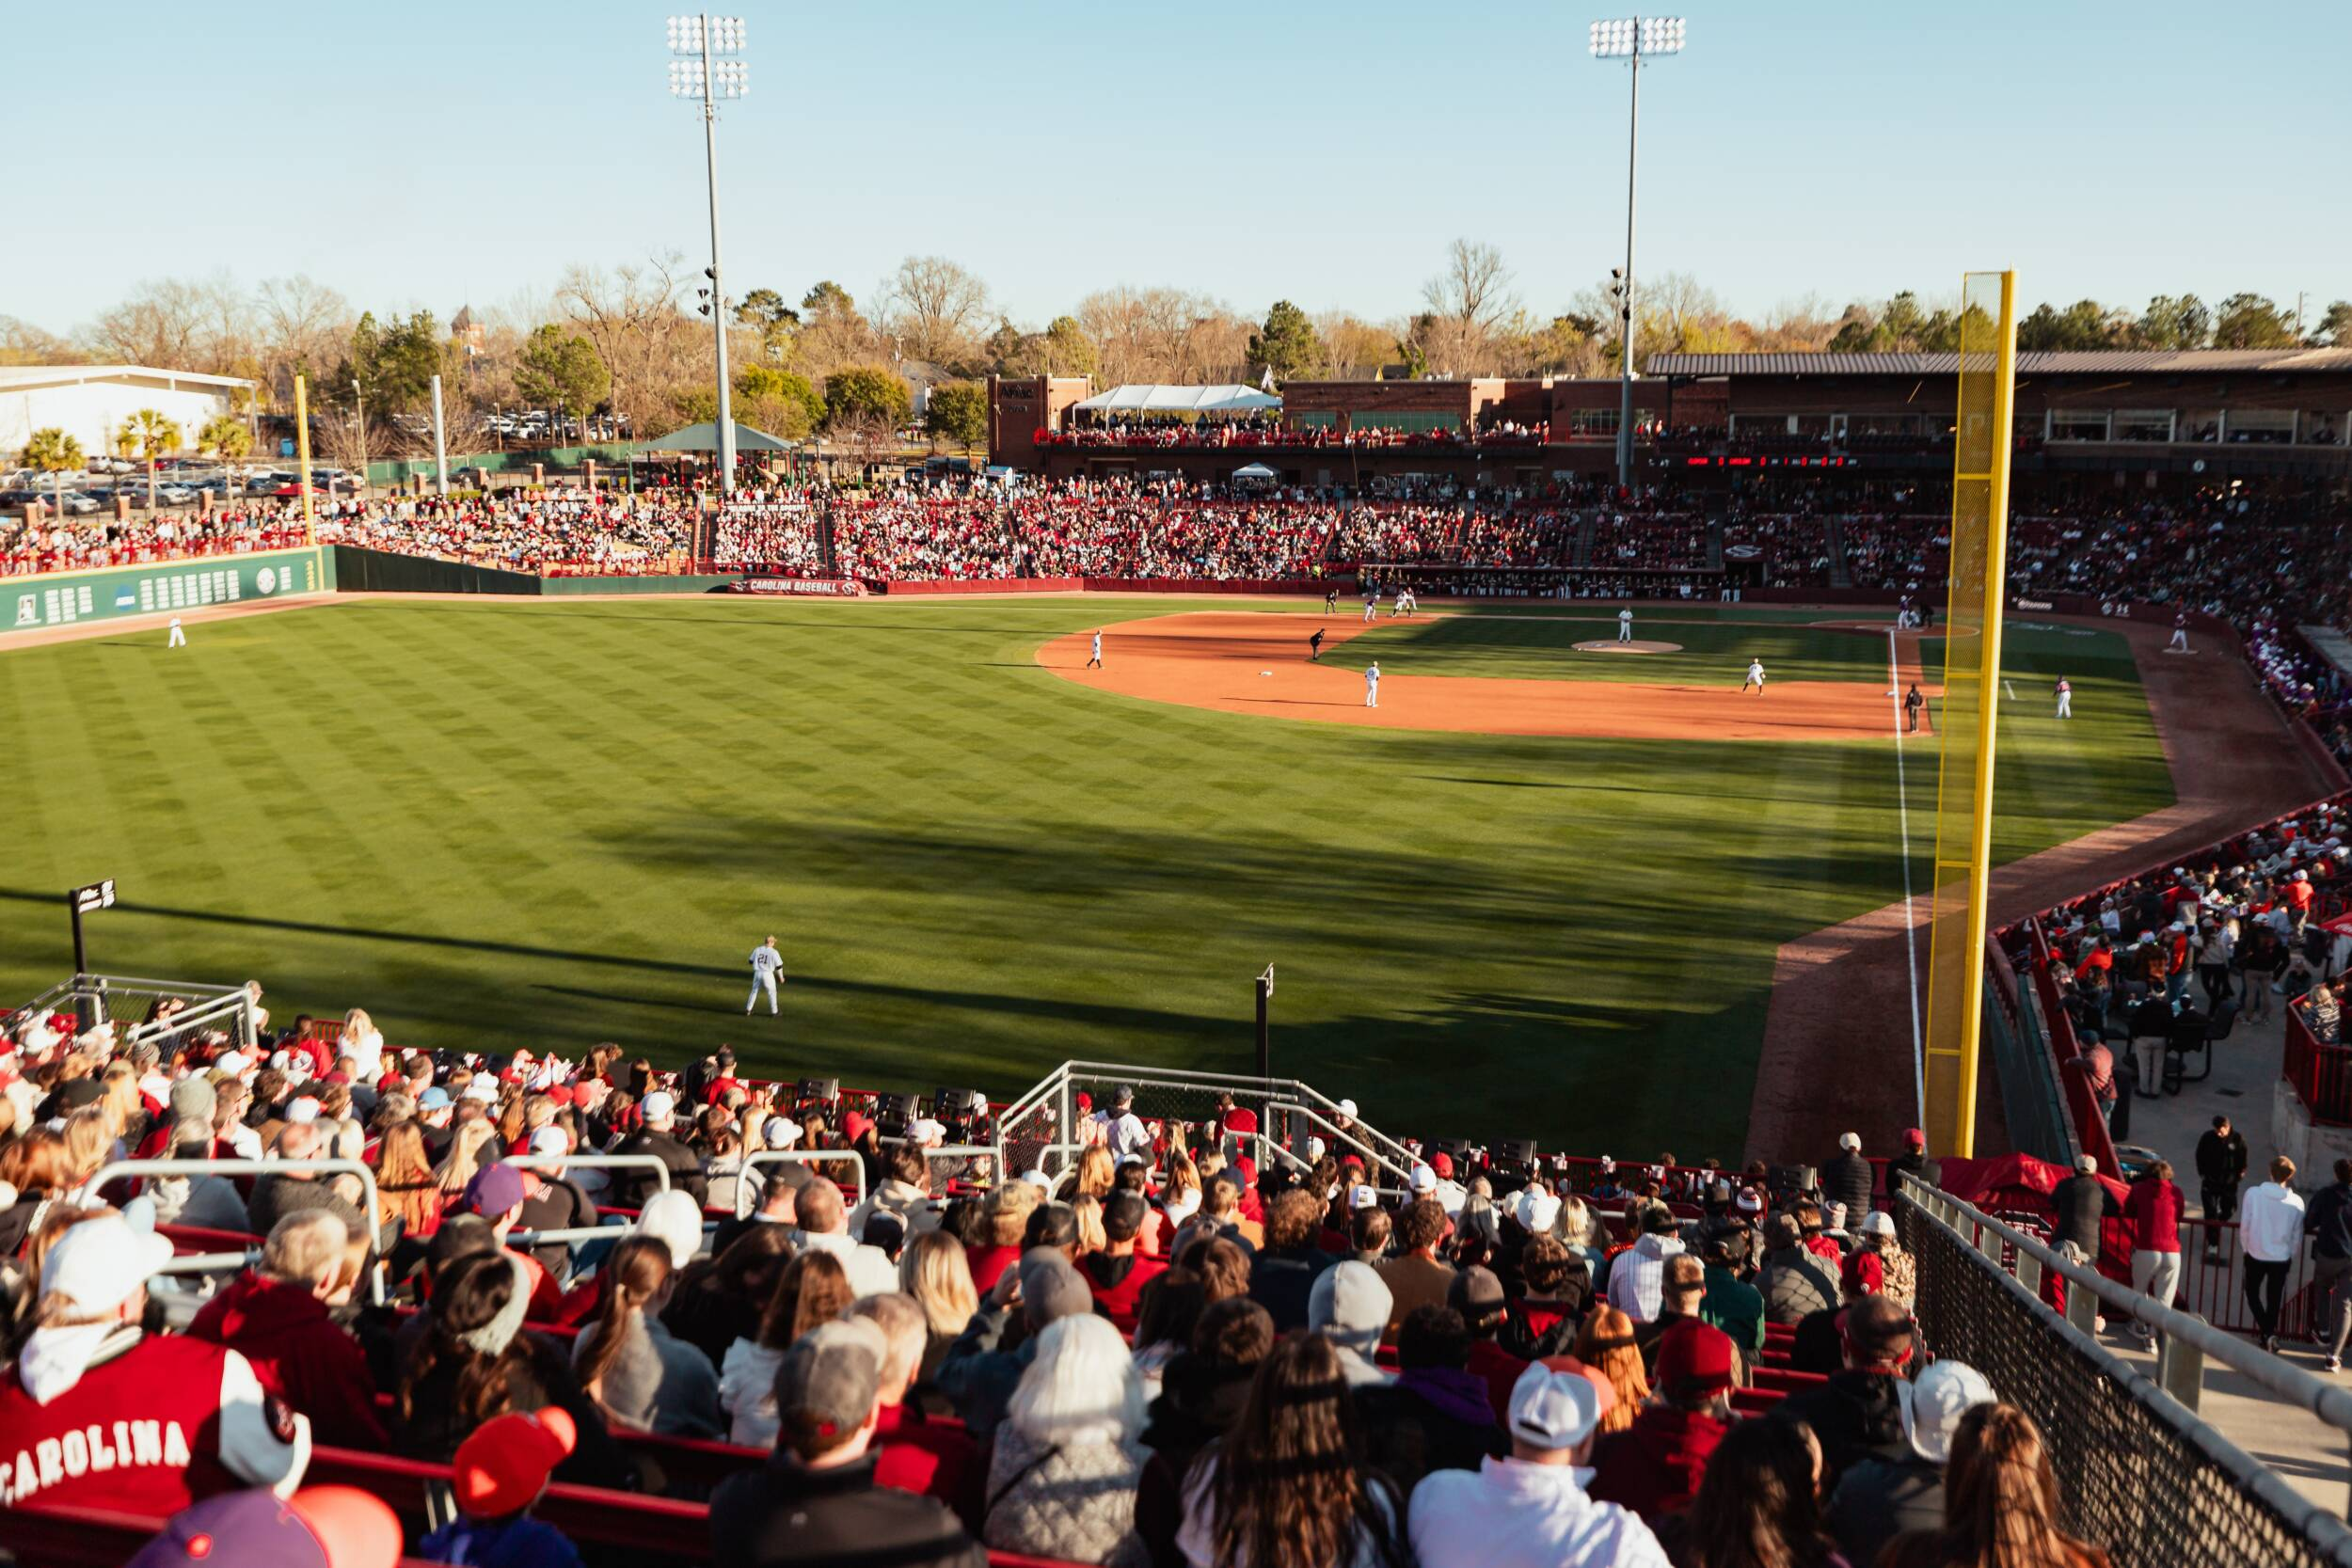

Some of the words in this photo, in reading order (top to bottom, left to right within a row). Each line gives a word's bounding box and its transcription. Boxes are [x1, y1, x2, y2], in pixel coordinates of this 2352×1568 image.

[751, 580, 791, 591] CAROLINA
[794, 581, 837, 593] BASEBALL
[757, 954, 768, 963] 21
[0, 1419, 191, 1507] CAROLINA
